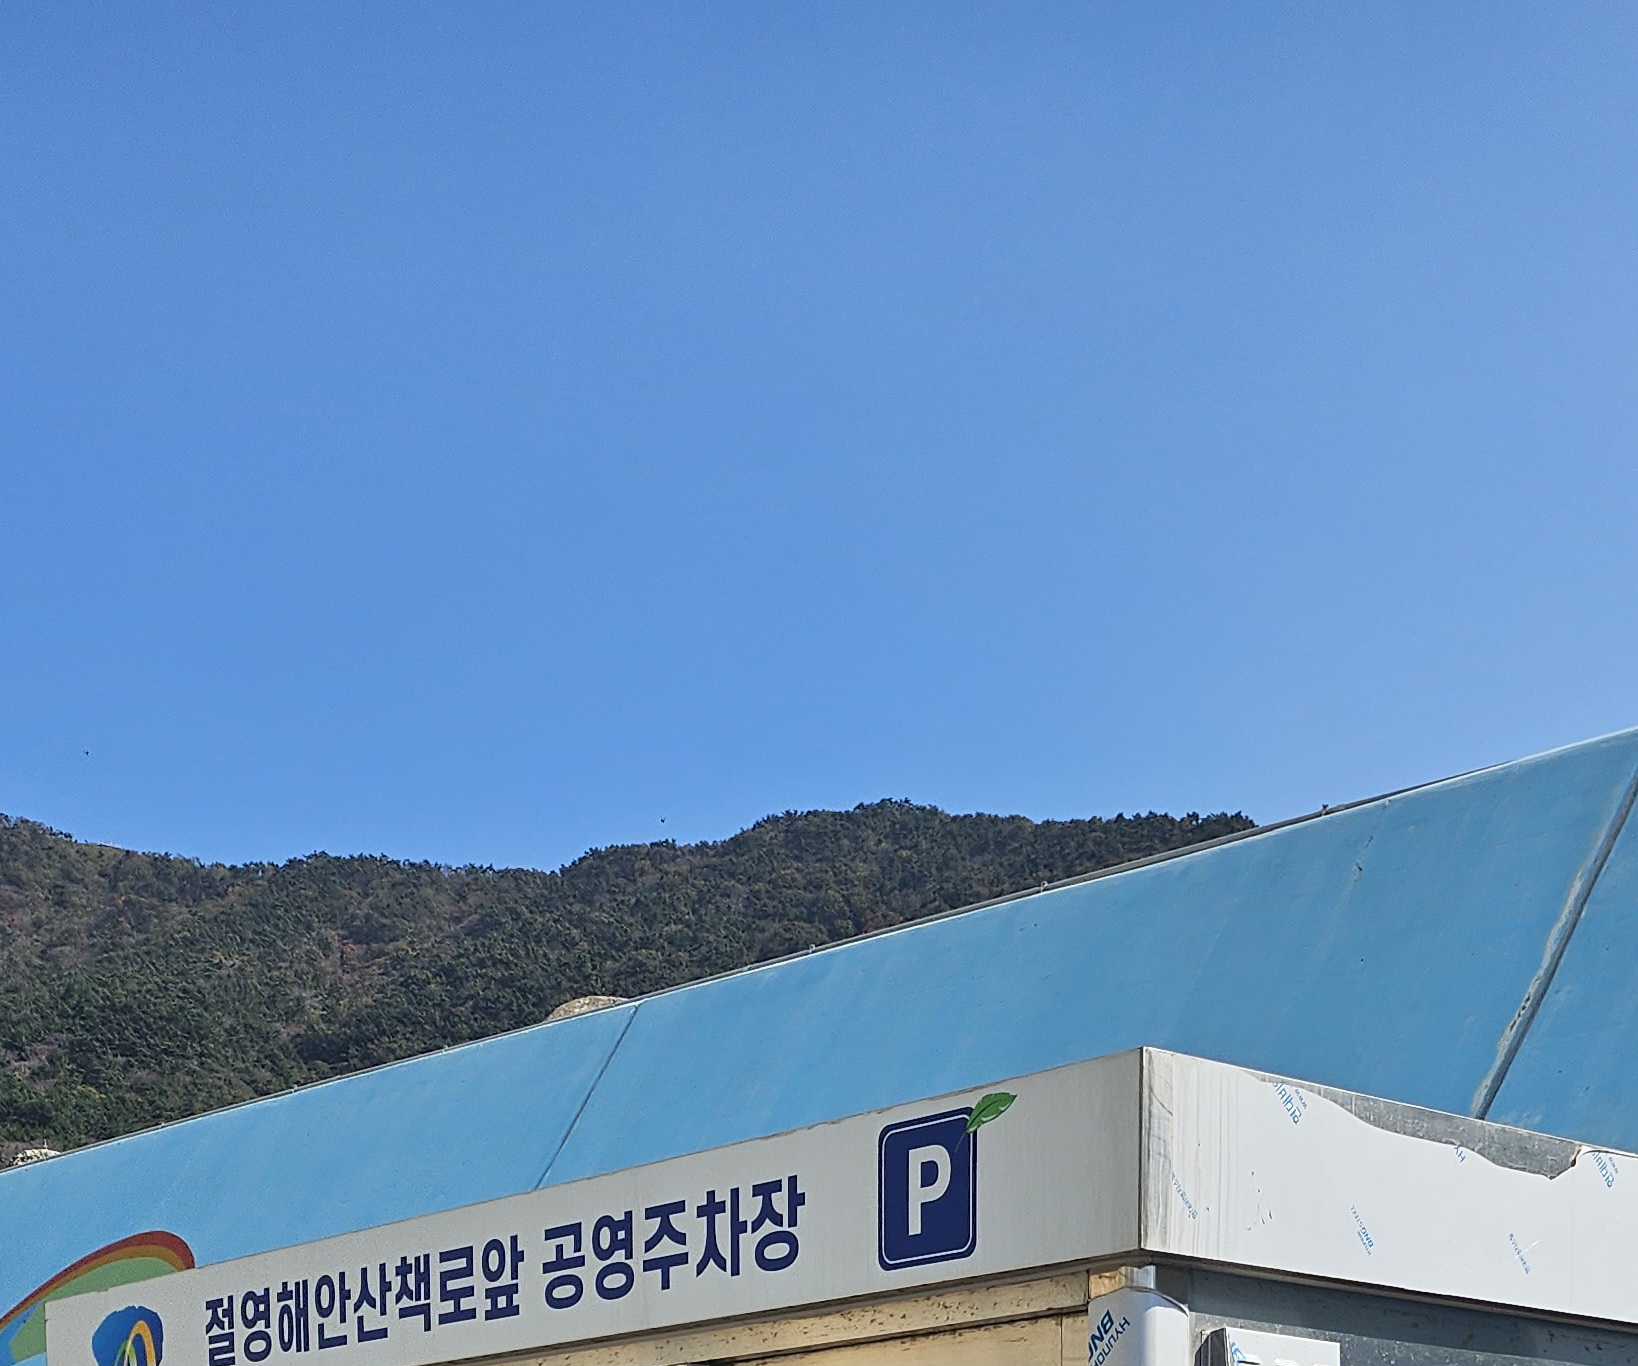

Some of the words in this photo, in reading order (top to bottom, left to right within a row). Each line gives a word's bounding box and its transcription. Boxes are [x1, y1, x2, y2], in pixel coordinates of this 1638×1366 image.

[1272, 1082, 1302, 1125] 현대비
[907, 1143, 952, 1237] P
[1591, 1151, 1615, 1188] 현대비
[541, 1174, 806, 1310] 공영주차장
